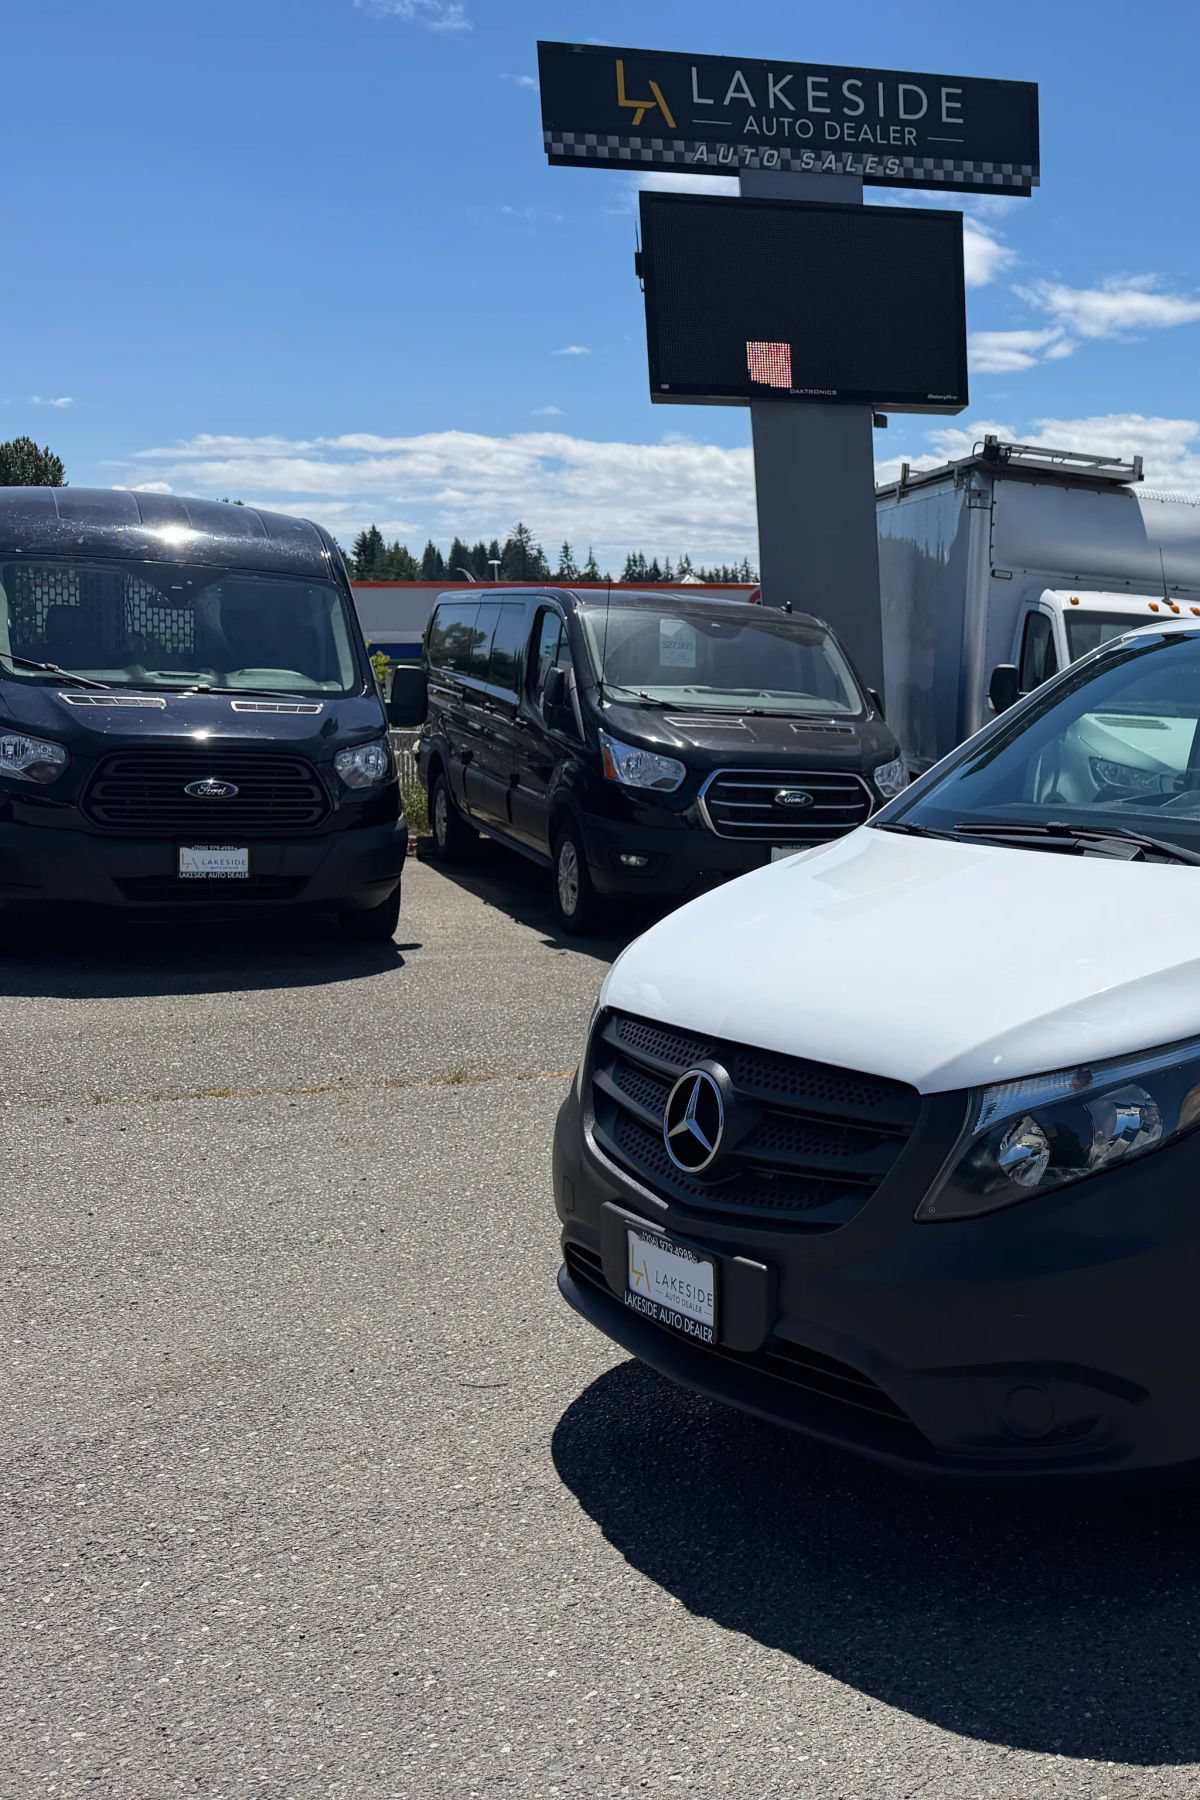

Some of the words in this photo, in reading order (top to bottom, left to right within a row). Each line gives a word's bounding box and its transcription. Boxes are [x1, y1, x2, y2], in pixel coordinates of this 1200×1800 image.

[691, 66, 964, 124] LAKESIDE
[743, 115, 814, 139] AUTO
[824, 121, 918, 146] DEALER
[693, 144, 781, 167] AUTO
[800, 152, 901, 175] SALES
[197, 783, 227, 796] Ford
[784, 793, 806, 804] Ford
[179, 871, 207, 879] LAKESIDE
[208, 871, 227, 879] AUTO
[227, 871, 249, 879] DEALER
[655, 1269, 713, 1308] LAKESIDE
[665, 1291, 680, 1304] AUTO
[681, 1299, 703, 1314] DEALER
[624, 1290, 658, 1319] LAKESIDE
[659, 1308, 683, 1329] AUTO
[684, 1318, 713, 1344] DEALER
